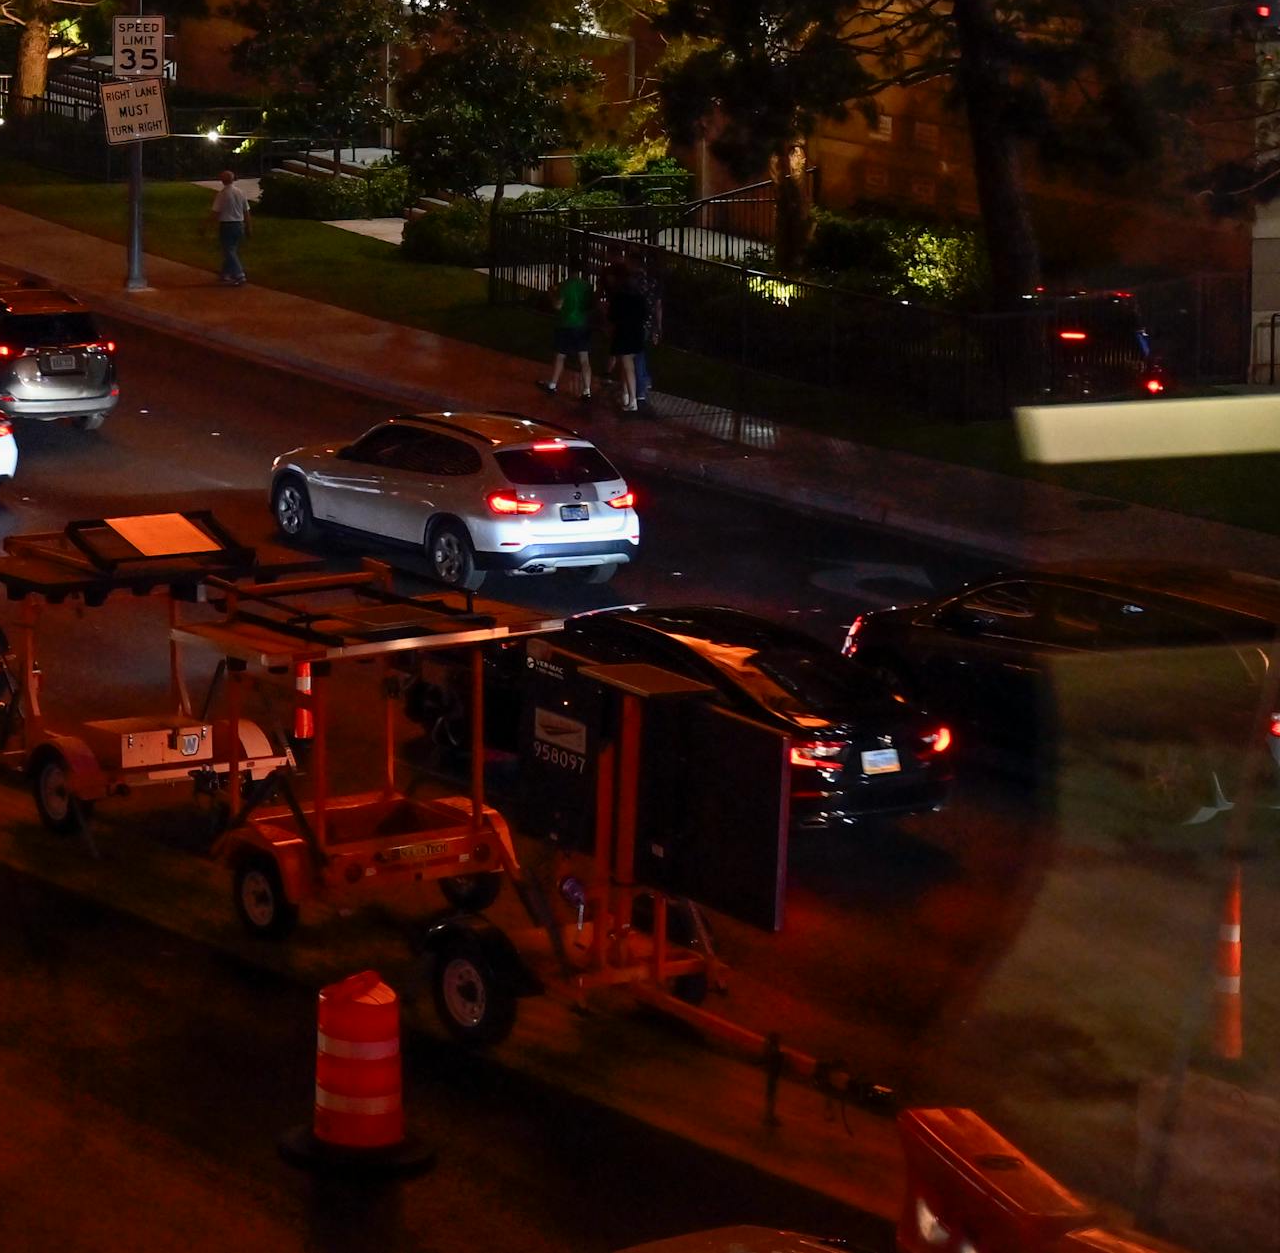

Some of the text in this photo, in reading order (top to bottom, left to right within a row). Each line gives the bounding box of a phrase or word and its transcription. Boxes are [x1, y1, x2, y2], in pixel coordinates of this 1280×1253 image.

[118, 23, 159, 33] SPEED
[122, 35, 155, 46] LIMIT
[119, 48, 158, 70] 35
[105, 85, 158, 101] RIGHT LANE
[119, 103, 149, 118] MUST
[110, 120, 163, 136] TURN RIGHT
[533, 740, 587, 776] 958097
